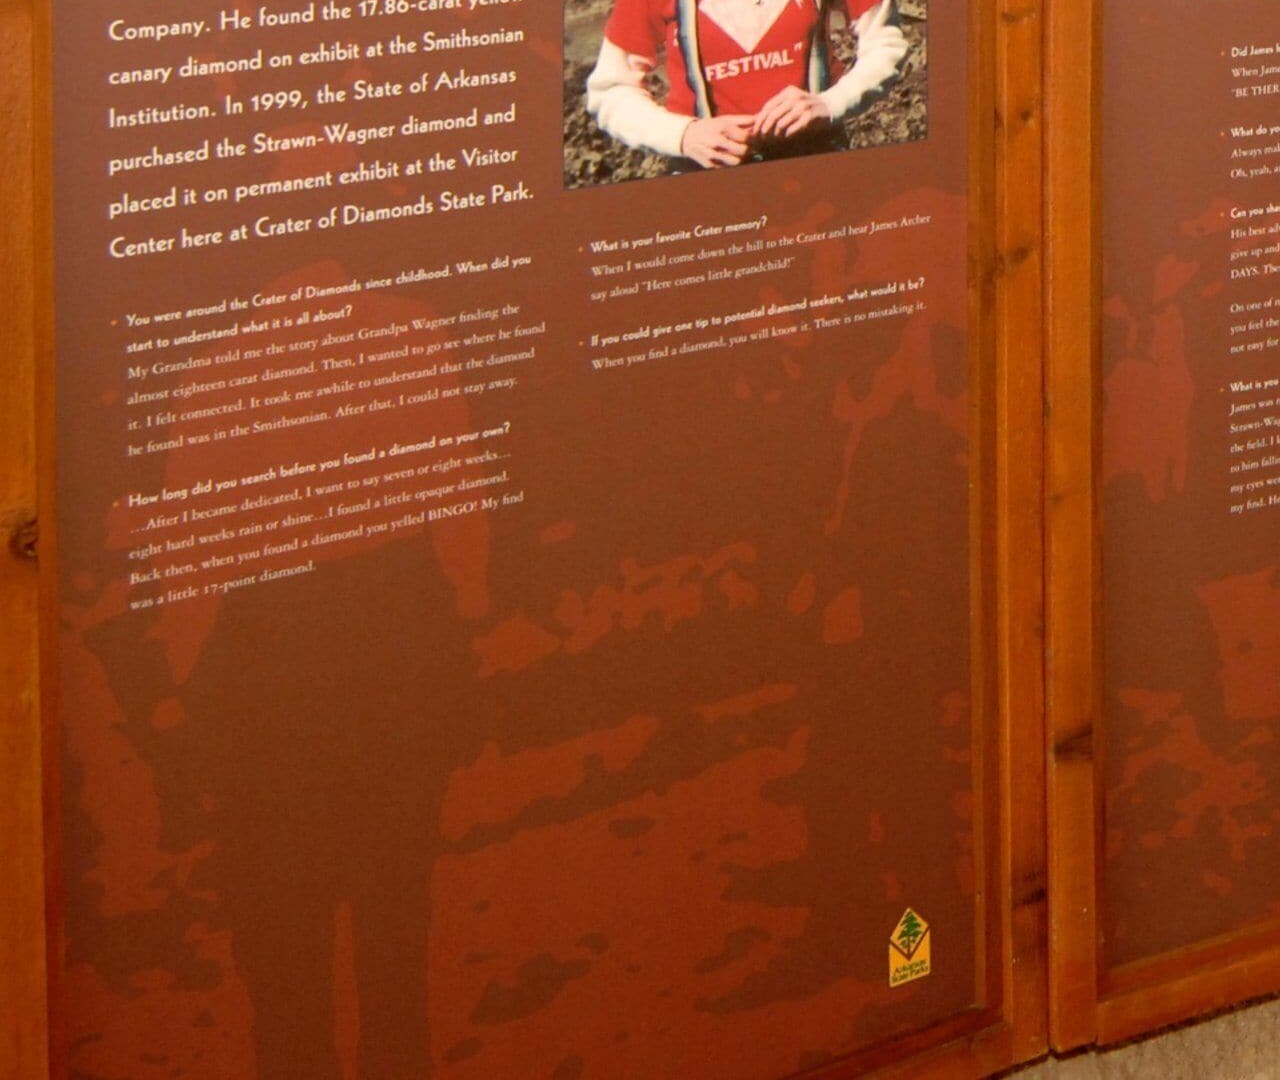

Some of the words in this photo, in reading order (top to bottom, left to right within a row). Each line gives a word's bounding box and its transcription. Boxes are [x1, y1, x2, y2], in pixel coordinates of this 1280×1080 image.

[126, 313, 150, 327] You
[154, 310, 182, 322] were
[185, 299, 226, 318] around
[230, 297, 249, 310] the
[252, 293, 287, 307] Crater
[290, 286, 302, 301] of
[305, 278, 362, 299] Diamonds
[365, 277, 392, 289] since
[395, 264, 452, 284] childhood.
[456, 260, 488, 274] When
[491, 254, 509, 270] did
[512, 256, 531, 268] you
